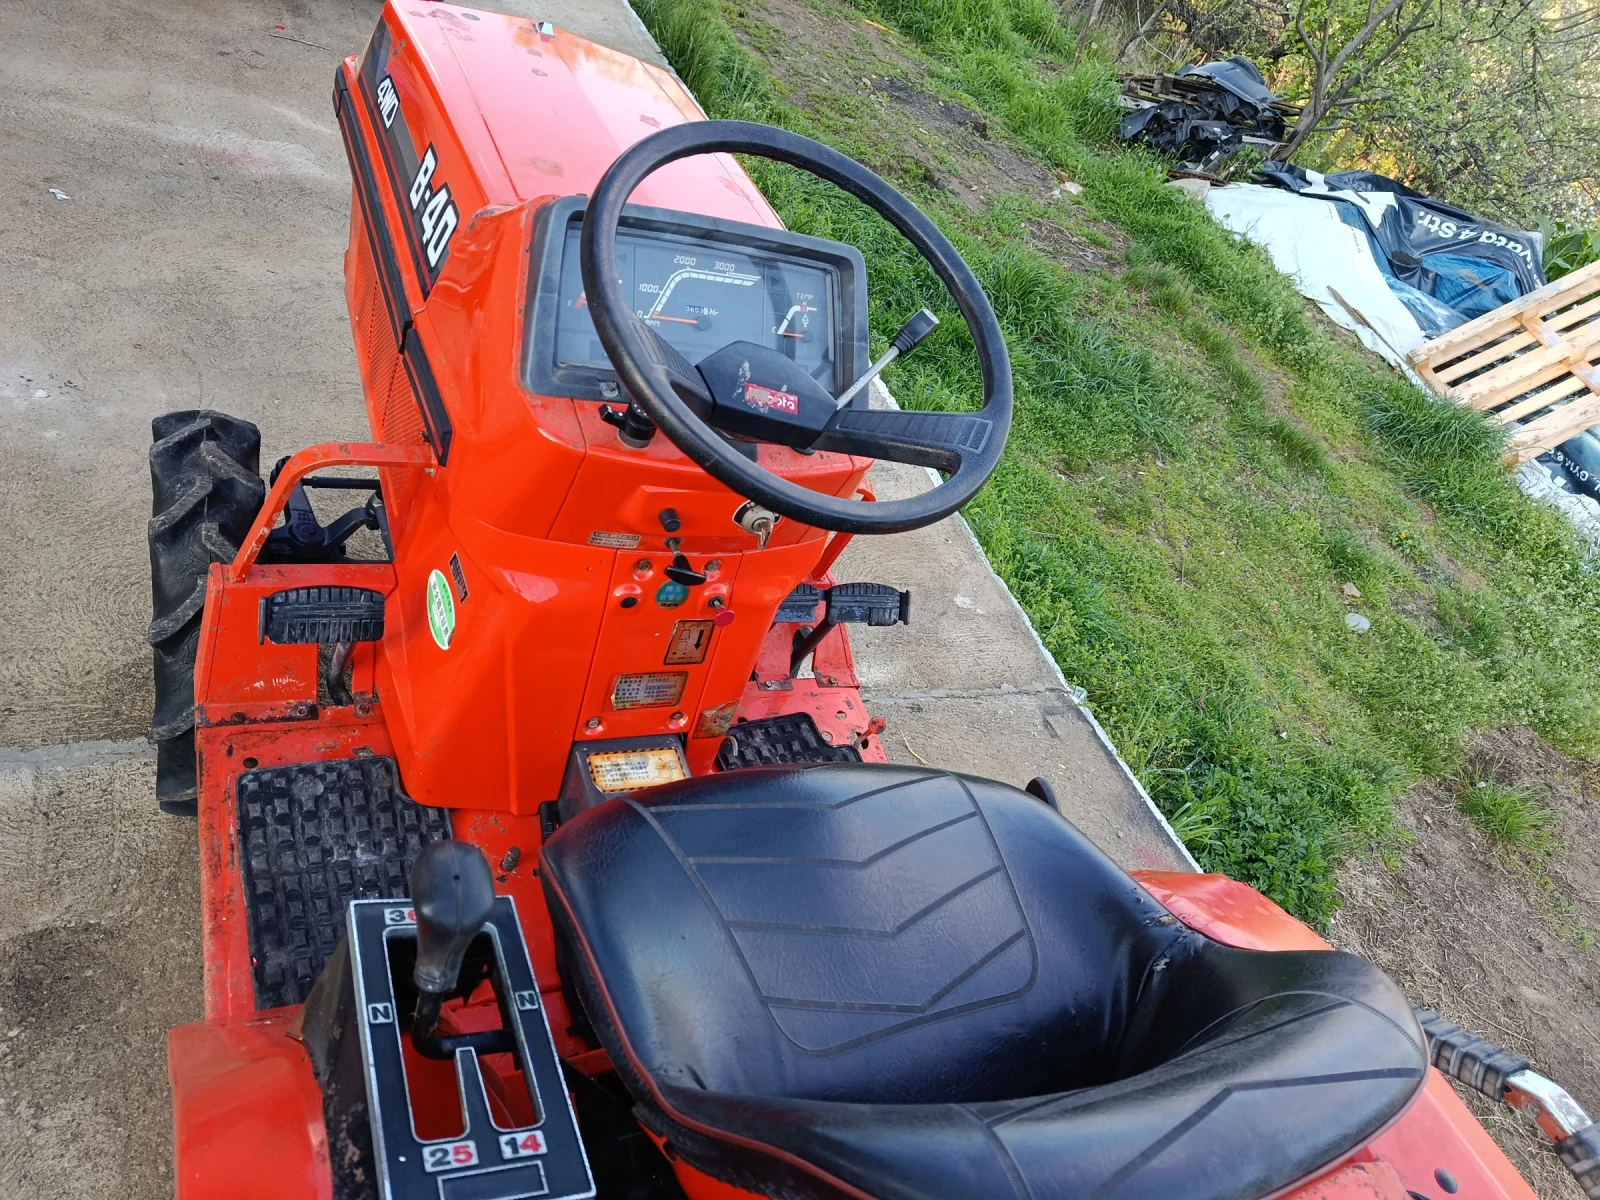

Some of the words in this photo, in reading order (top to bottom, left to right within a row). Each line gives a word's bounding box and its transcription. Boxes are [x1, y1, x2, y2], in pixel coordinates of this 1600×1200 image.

[377, 77, 399, 129] 4WD
[409, 147, 458, 268] B-40
[1417, 211, 1457, 239] Str.
[1458, 229, 1478, 240] 4
[673, 254, 697, 266] 2000
[714, 261, 736, 272] 3000
[639, 283, 659, 294] 1000
[796, 292, 814, 300] TEMP
[636, 310, 644, 318] 0
[516, 992, 537, 1009] N
[370, 1005, 391, 1023] N
[504, 1133, 542, 1155] 14
[428, 1144, 474, 1169] 25
